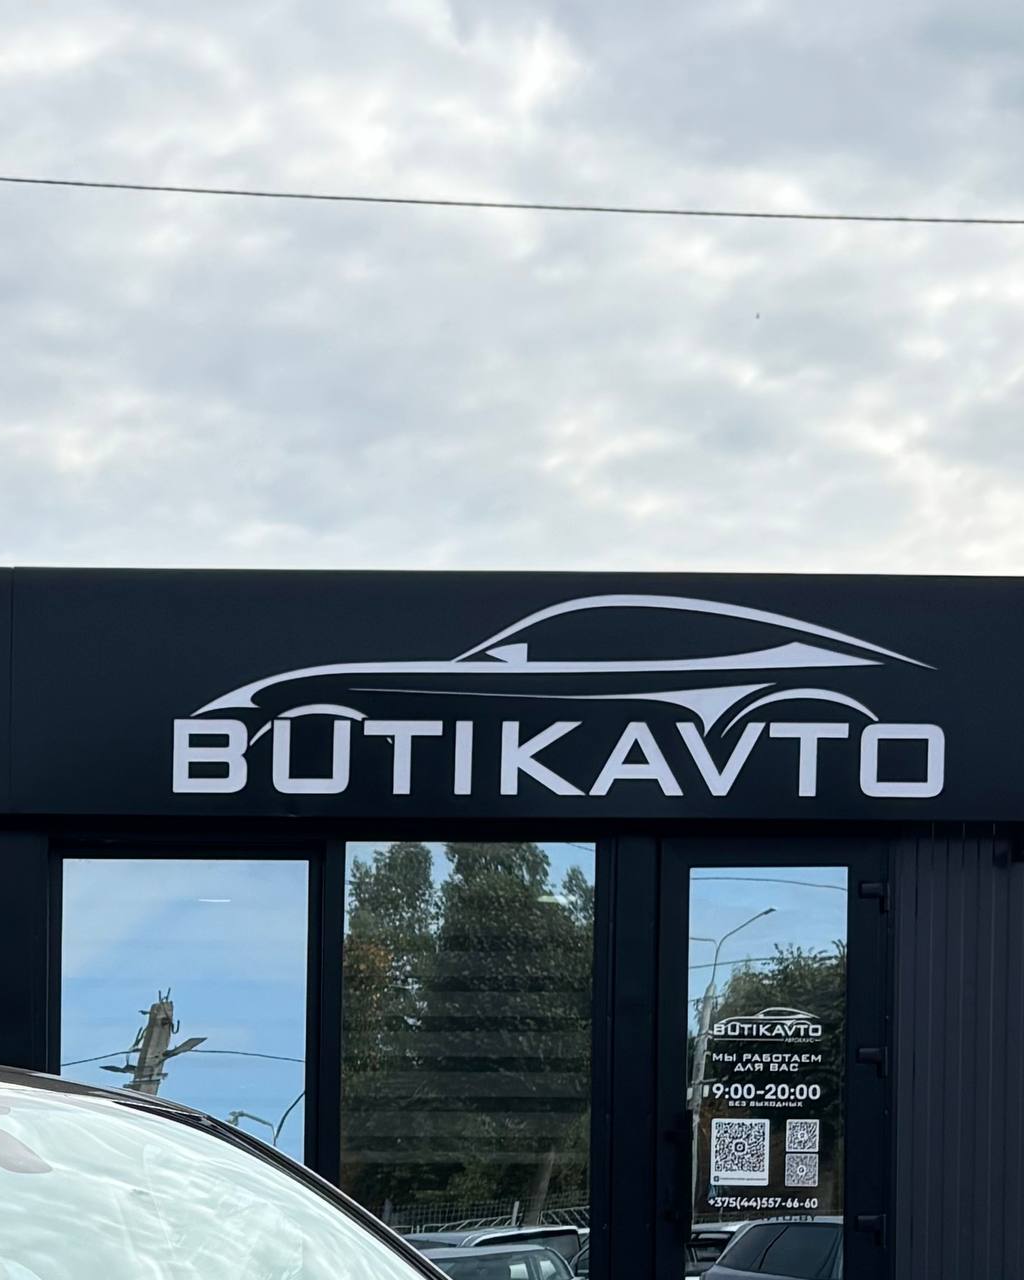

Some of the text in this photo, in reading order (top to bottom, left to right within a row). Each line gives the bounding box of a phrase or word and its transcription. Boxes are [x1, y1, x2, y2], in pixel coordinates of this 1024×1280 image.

[173, 718, 945, 798] BUTIKAVTO
[713, 1023, 822, 1037] BUTIKAVTO
[712, 1053, 822, 1063] МЫ РАБОТАЕМ
[734, 1063, 799, 1072] ДЛЯ ВАС
[712, 1084, 821, 1100] 9:00-20:00
[708, 1197, 819, 1210] +375(44)557-66-60
